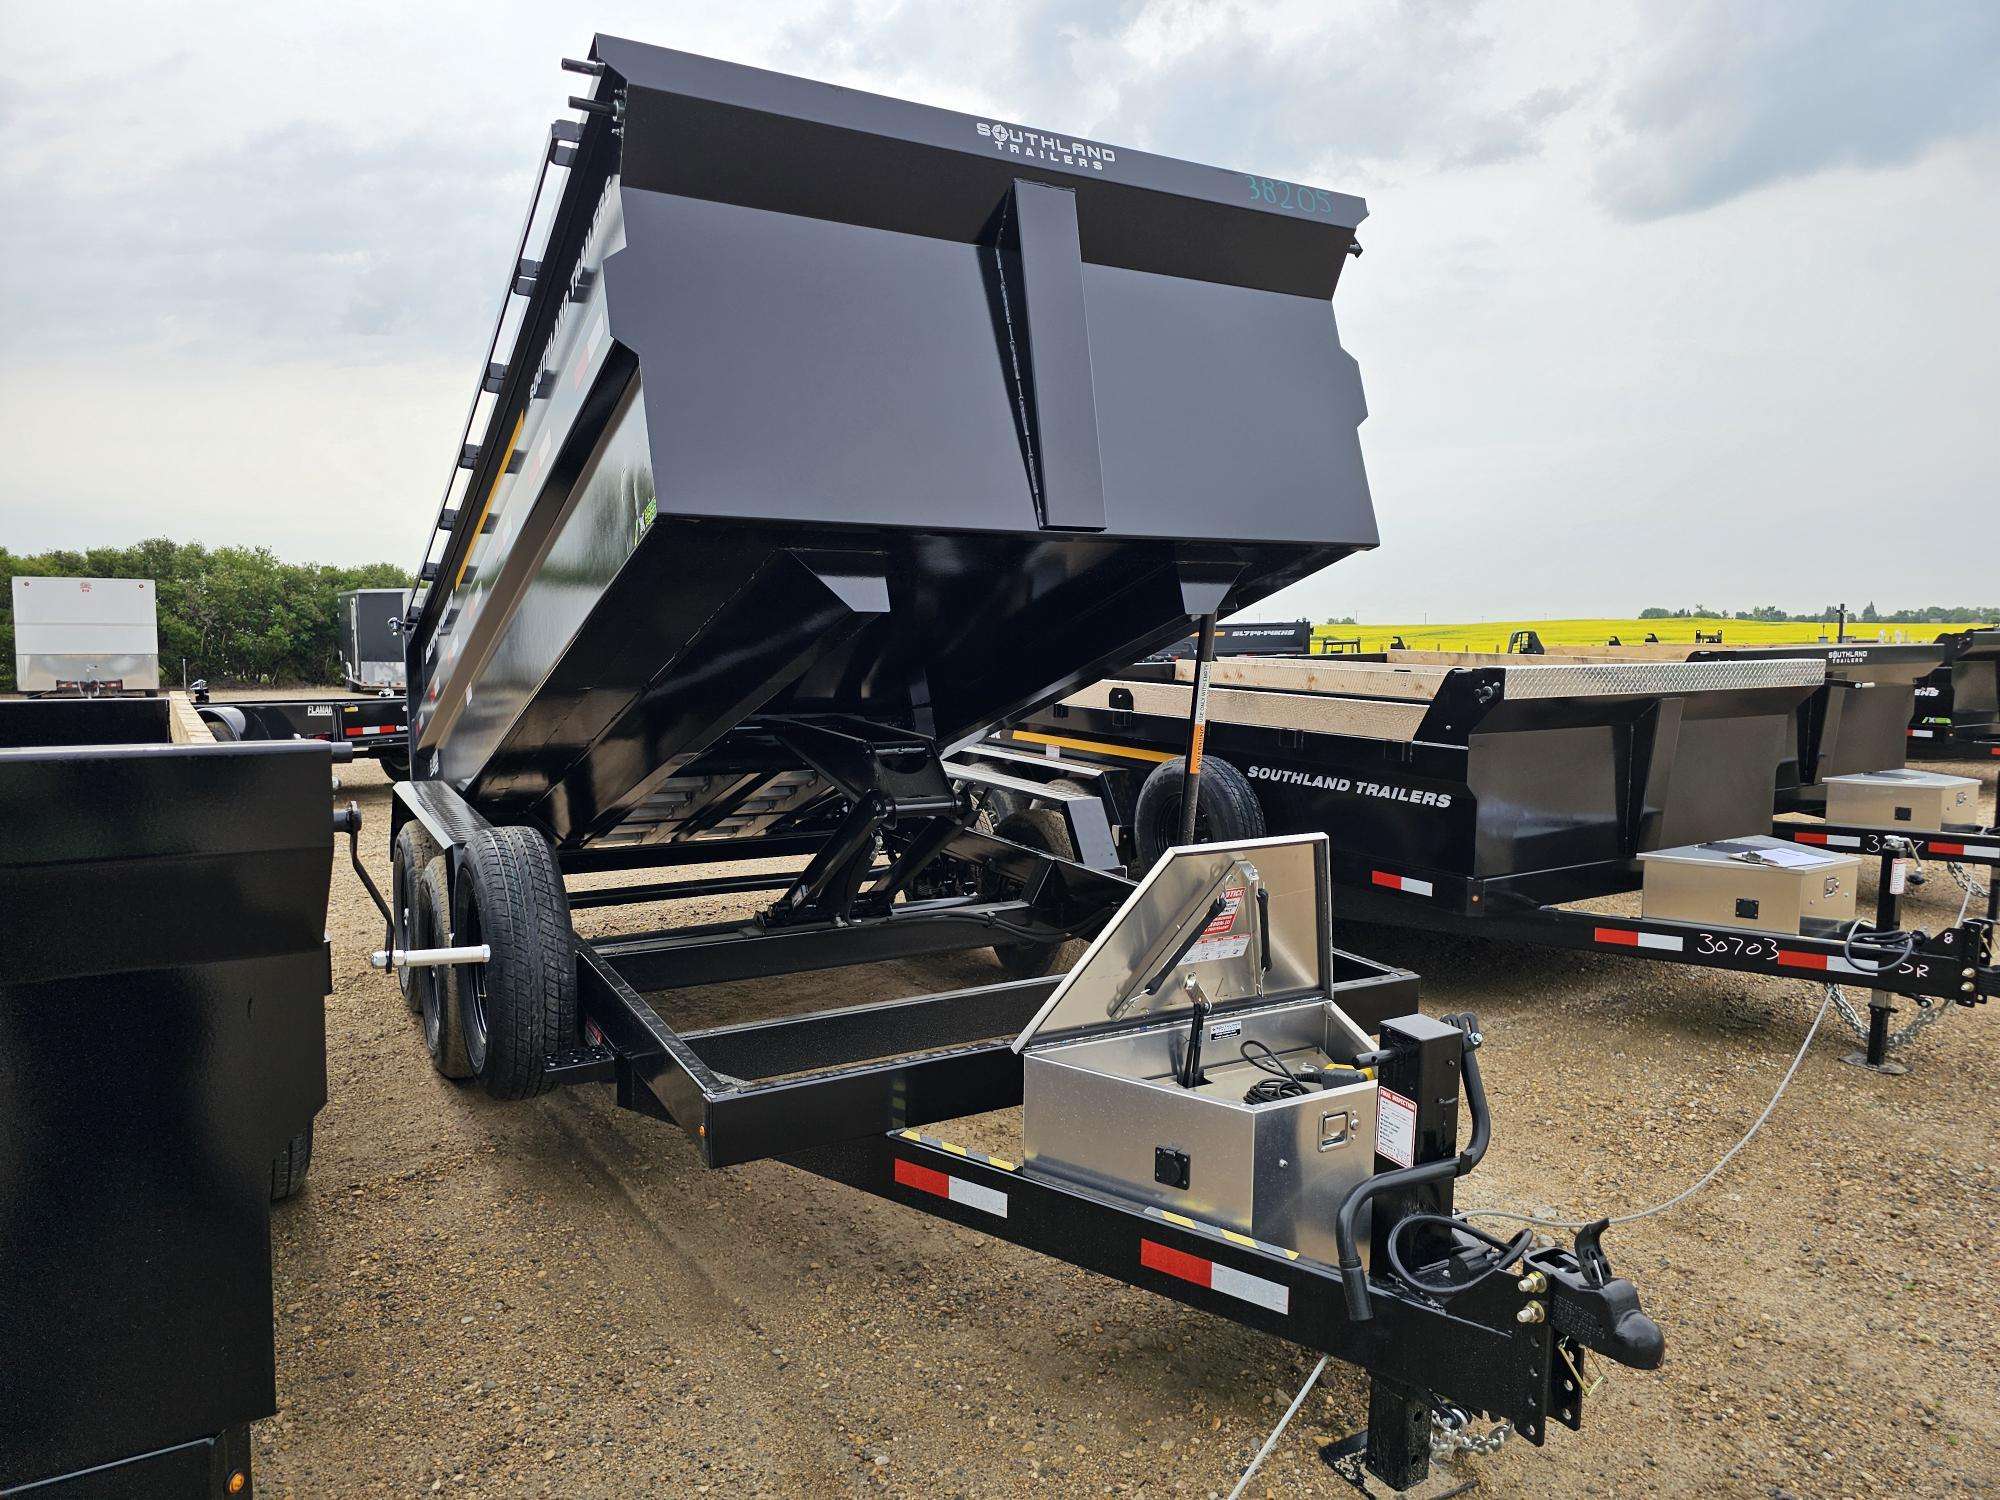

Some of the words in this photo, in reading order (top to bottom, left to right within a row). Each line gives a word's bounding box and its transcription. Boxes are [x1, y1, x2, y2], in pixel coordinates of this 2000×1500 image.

[976, 122, 1116, 162] SOUTHLAND
[994, 140, 1103, 171] TRAILERS
[1245, 175, 1334, 216] 38205
[1828, 650, 1868, 659] SOUTHLAND
[1247, 765, 1351, 792] SOUTHLAND
[1356, 781, 1452, 808] TRAILERS
[1697, 933, 1779, 960] 30703
